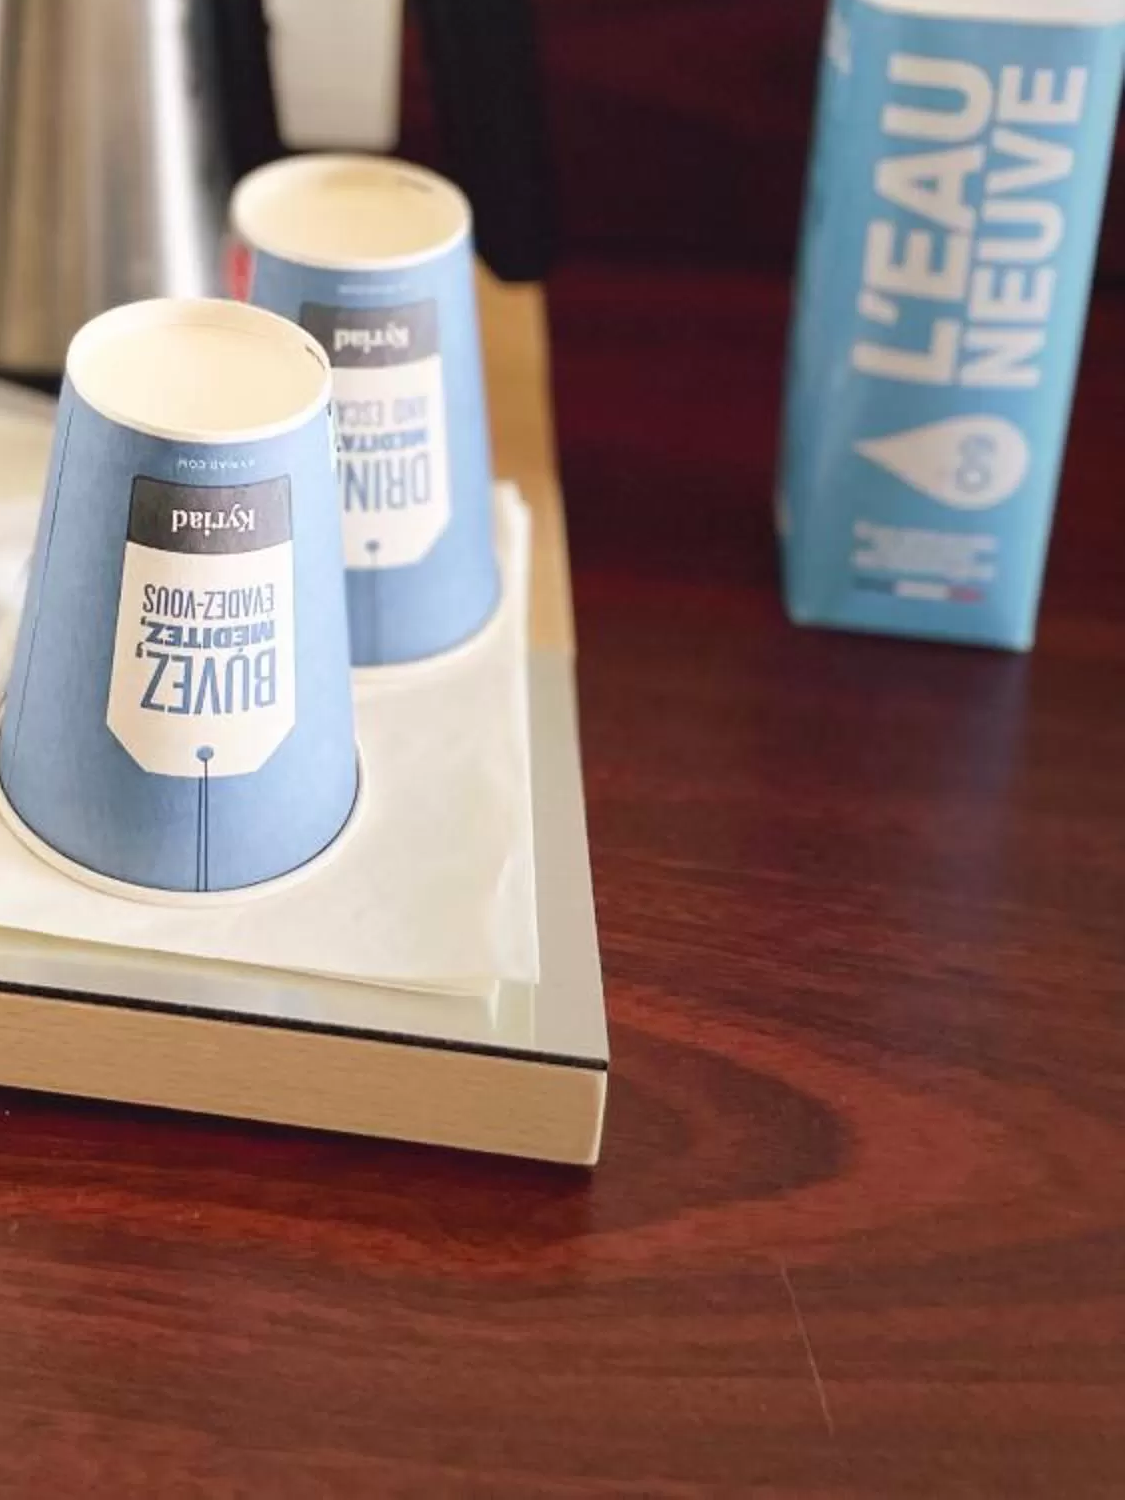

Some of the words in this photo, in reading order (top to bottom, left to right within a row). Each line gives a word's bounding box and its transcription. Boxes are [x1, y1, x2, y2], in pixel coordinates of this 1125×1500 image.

[851, 53, 994, 386] L'EAU
[958, 64, 1089, 389] NEUVE
[334, 323, 410, 354] Kyriad
[337, 453, 432, 513] DRIN
[171, 503, 256, 536] Kyriad
[142, 583, 276, 620] ÉVADEZ-VOUS
[139, 616, 276, 657] MÉDITEZ,
[135, 641, 277, 718] BUVEZ,
